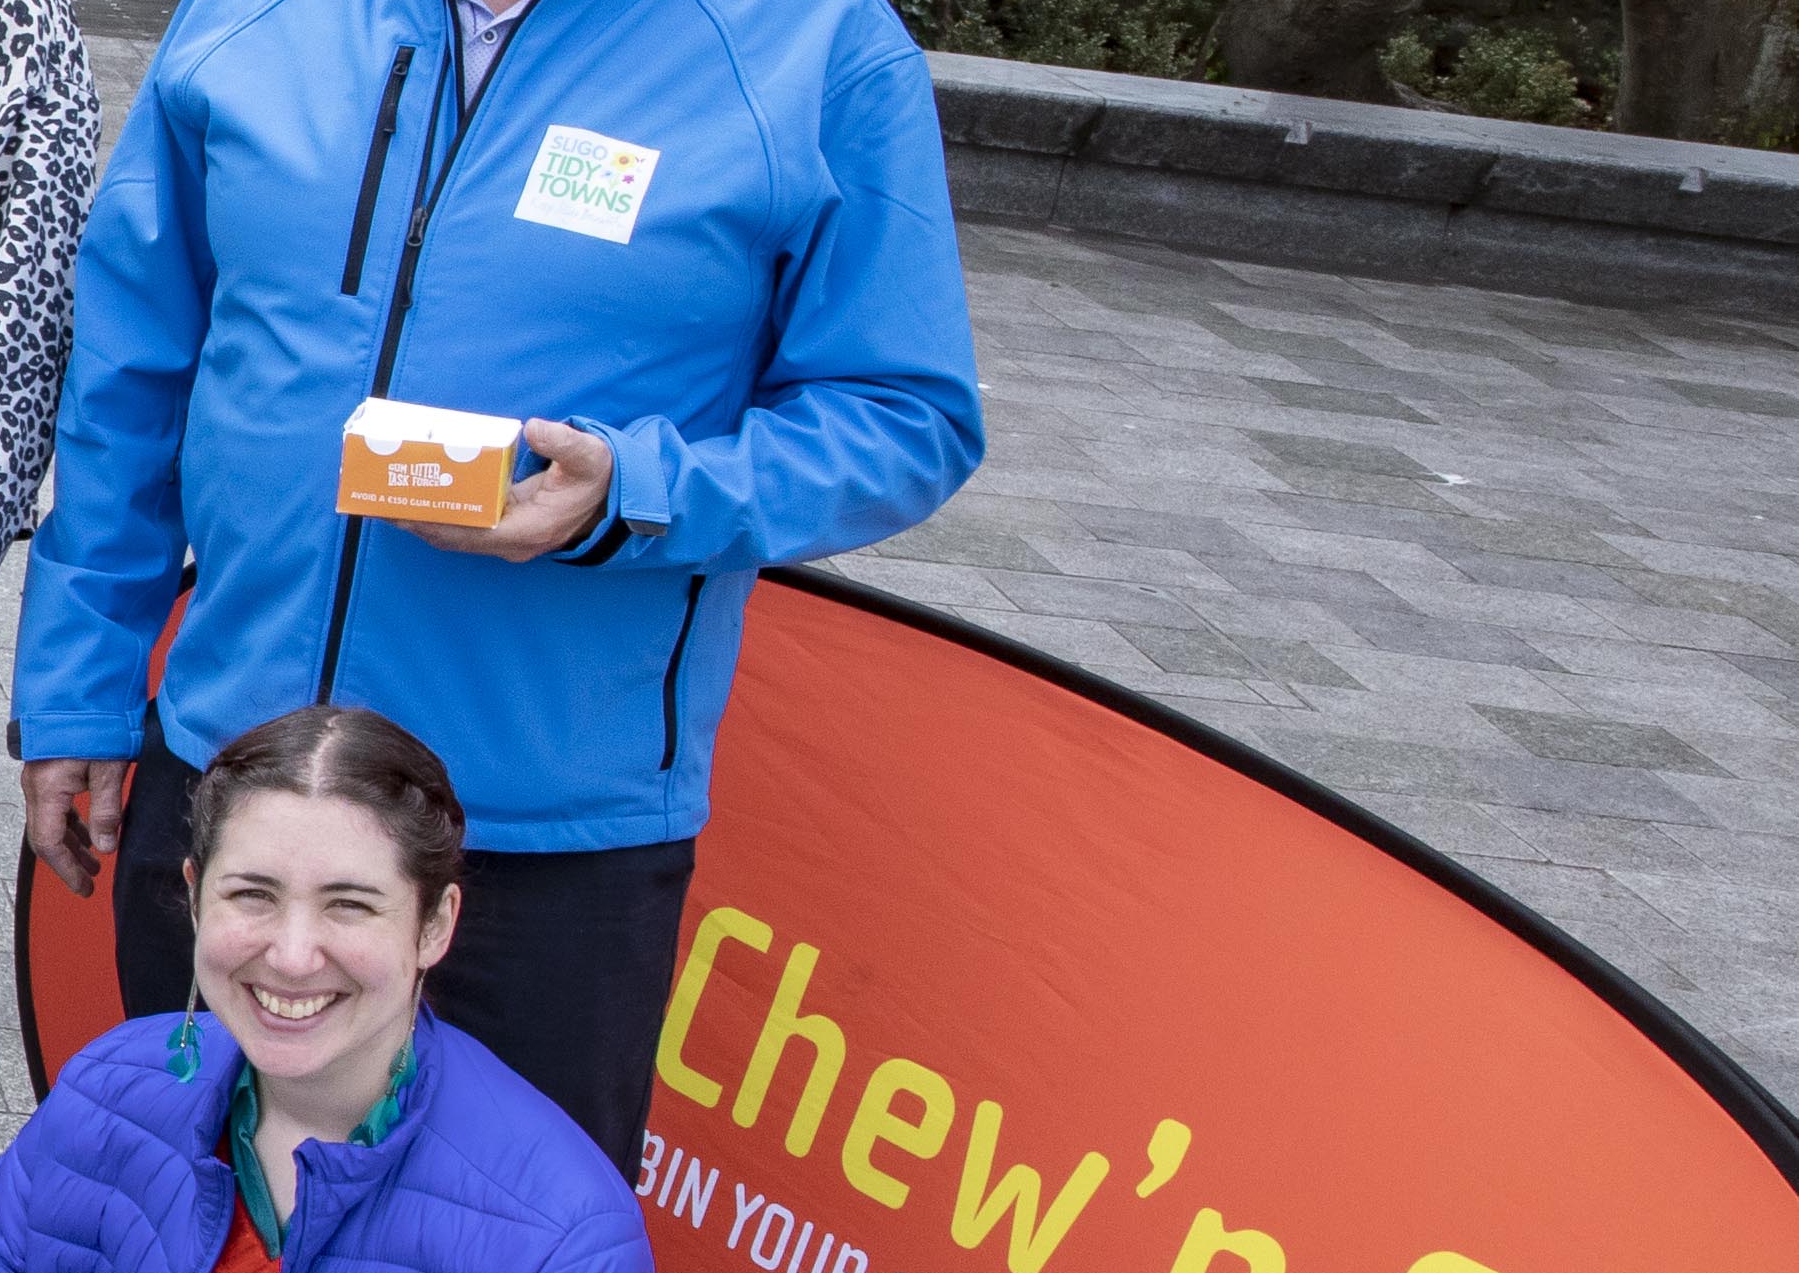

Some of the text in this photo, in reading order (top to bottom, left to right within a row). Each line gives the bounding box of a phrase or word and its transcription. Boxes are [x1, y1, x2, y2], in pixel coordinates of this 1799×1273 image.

[551, 135, 608, 161] SLIGO
[546, 152, 602, 181] TIDY
[538, 172, 634, 214] TOWNS
[388, 462, 441, 479] GUM LITTER
[388, 470, 441, 487] TASK FORCE
[350, 491, 377, 502] AVOID
[378, 494, 386, 502] A
[410, 498, 430, 507] GUM
[432, 500, 462, 511] LITTER
[463, 503, 483, 513] FINE
[636, 1129, 720, 1229] BIN
